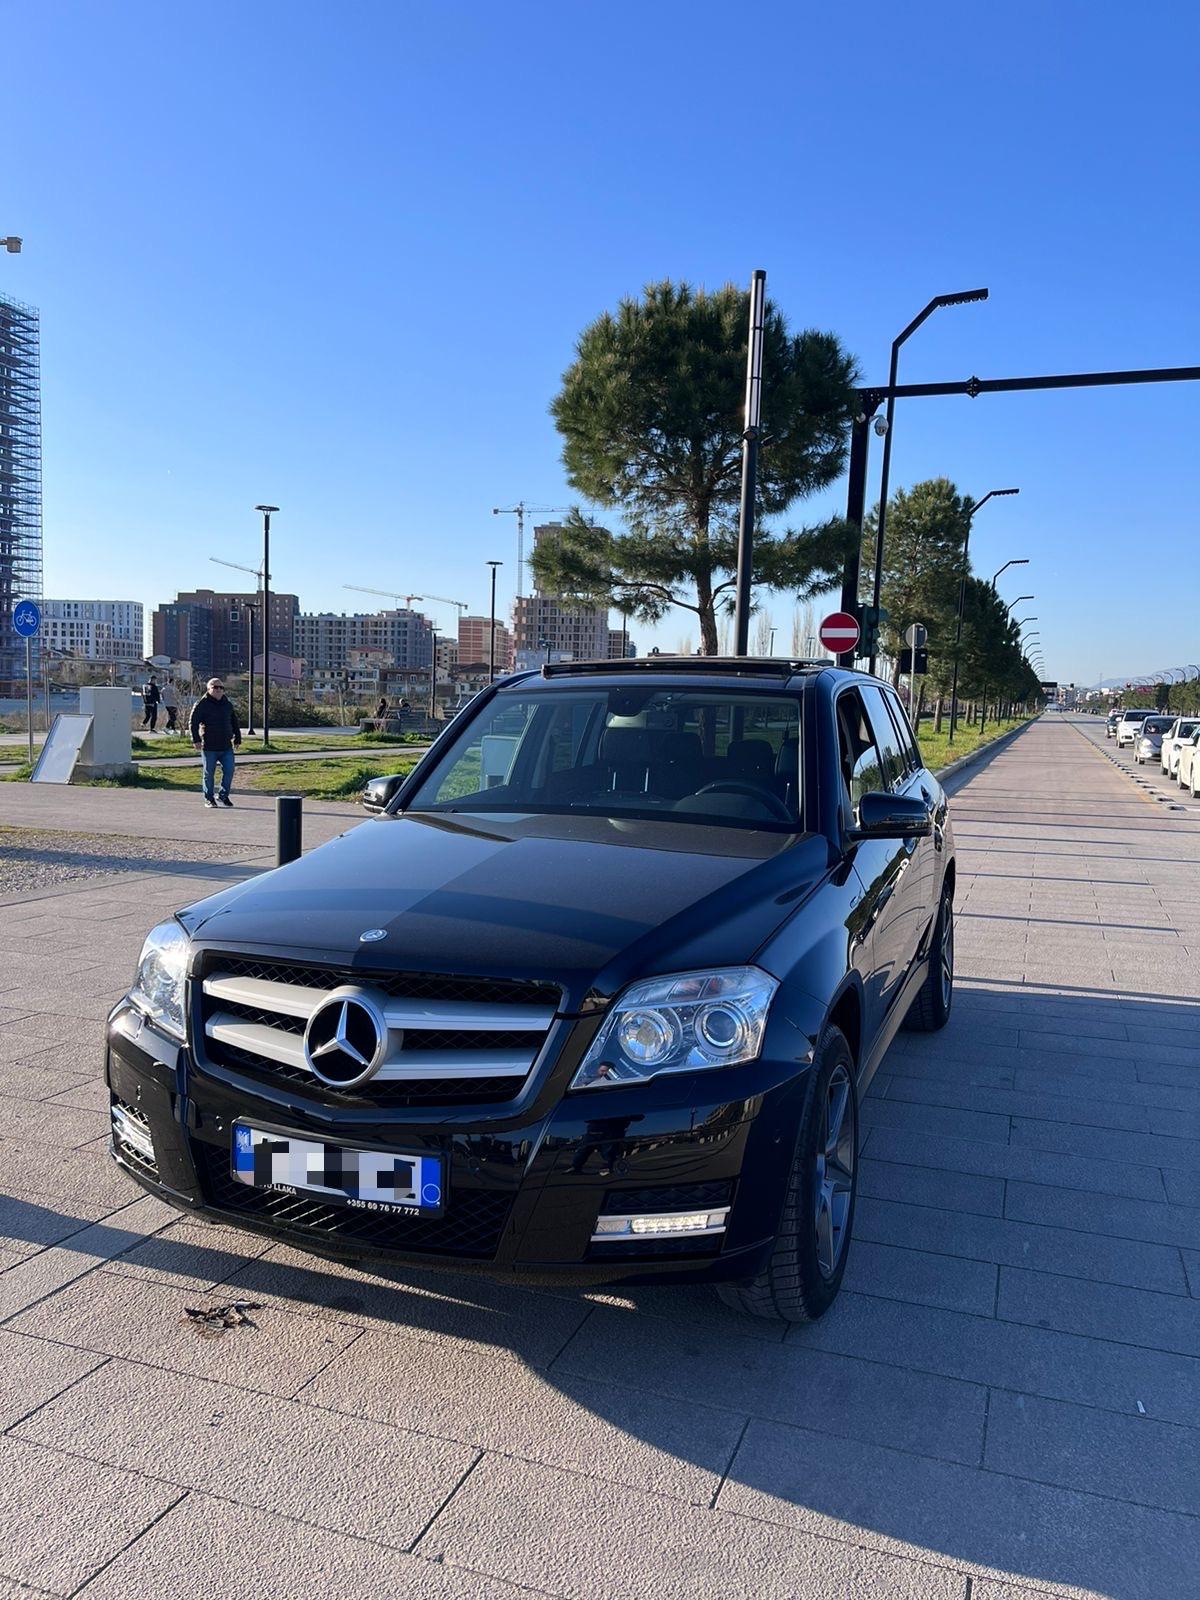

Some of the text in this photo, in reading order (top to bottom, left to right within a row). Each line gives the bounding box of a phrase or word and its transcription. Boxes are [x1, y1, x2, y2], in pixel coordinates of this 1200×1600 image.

[273, 1184, 297, 1195] LLAKA
[346, 1199, 420, 1216] +355 69 76 77 772
